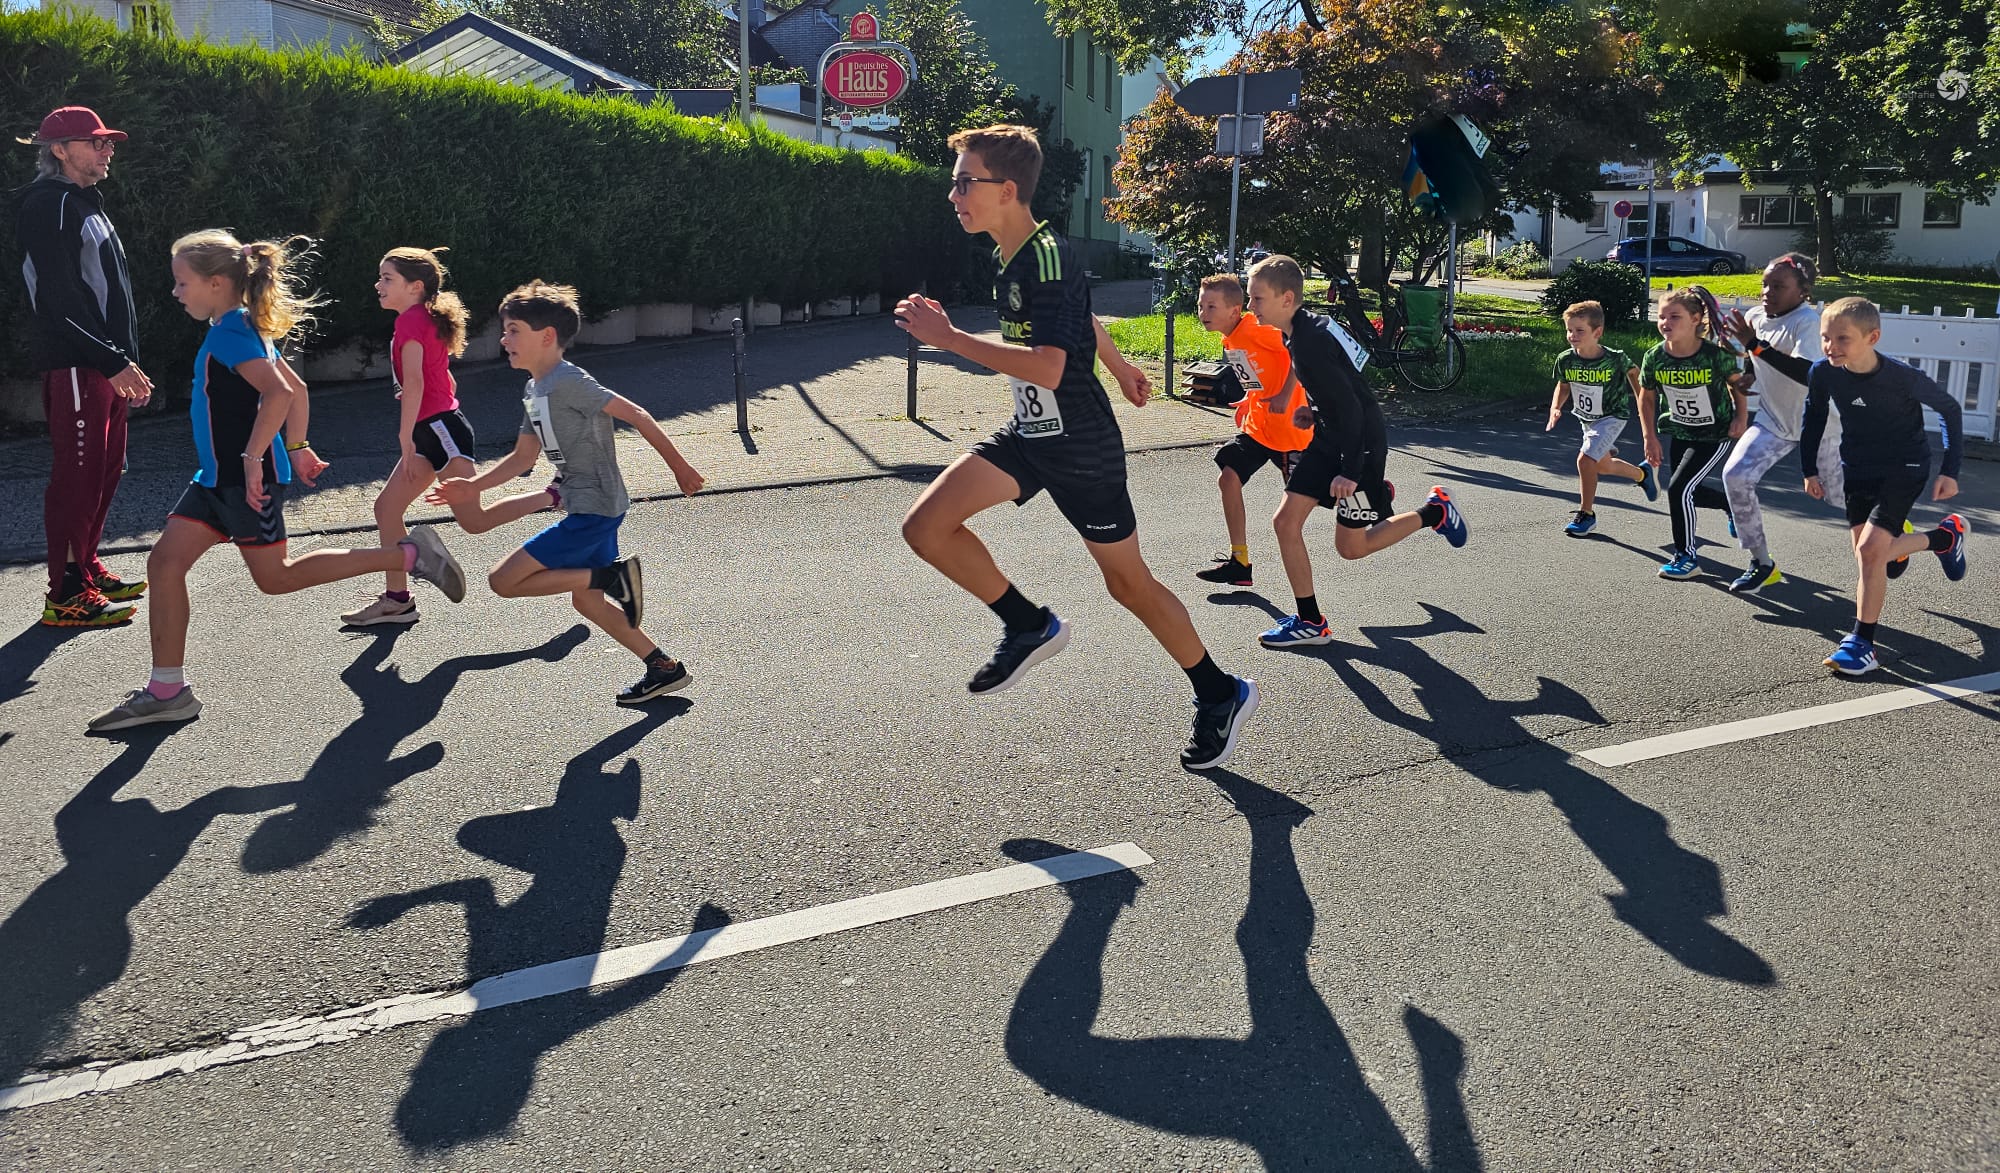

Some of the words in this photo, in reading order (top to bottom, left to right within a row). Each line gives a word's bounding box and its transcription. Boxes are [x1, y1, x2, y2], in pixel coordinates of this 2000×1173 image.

[854, 61, 889, 70] Deutsches
[839, 62, 888, 91] Haus
[1565, 368, 1612, 383] AWESOME
[1655, 368, 1712, 385] AWESOME
[1579, 394, 1593, 412] 69
[1676, 399, 1700, 416] 65
